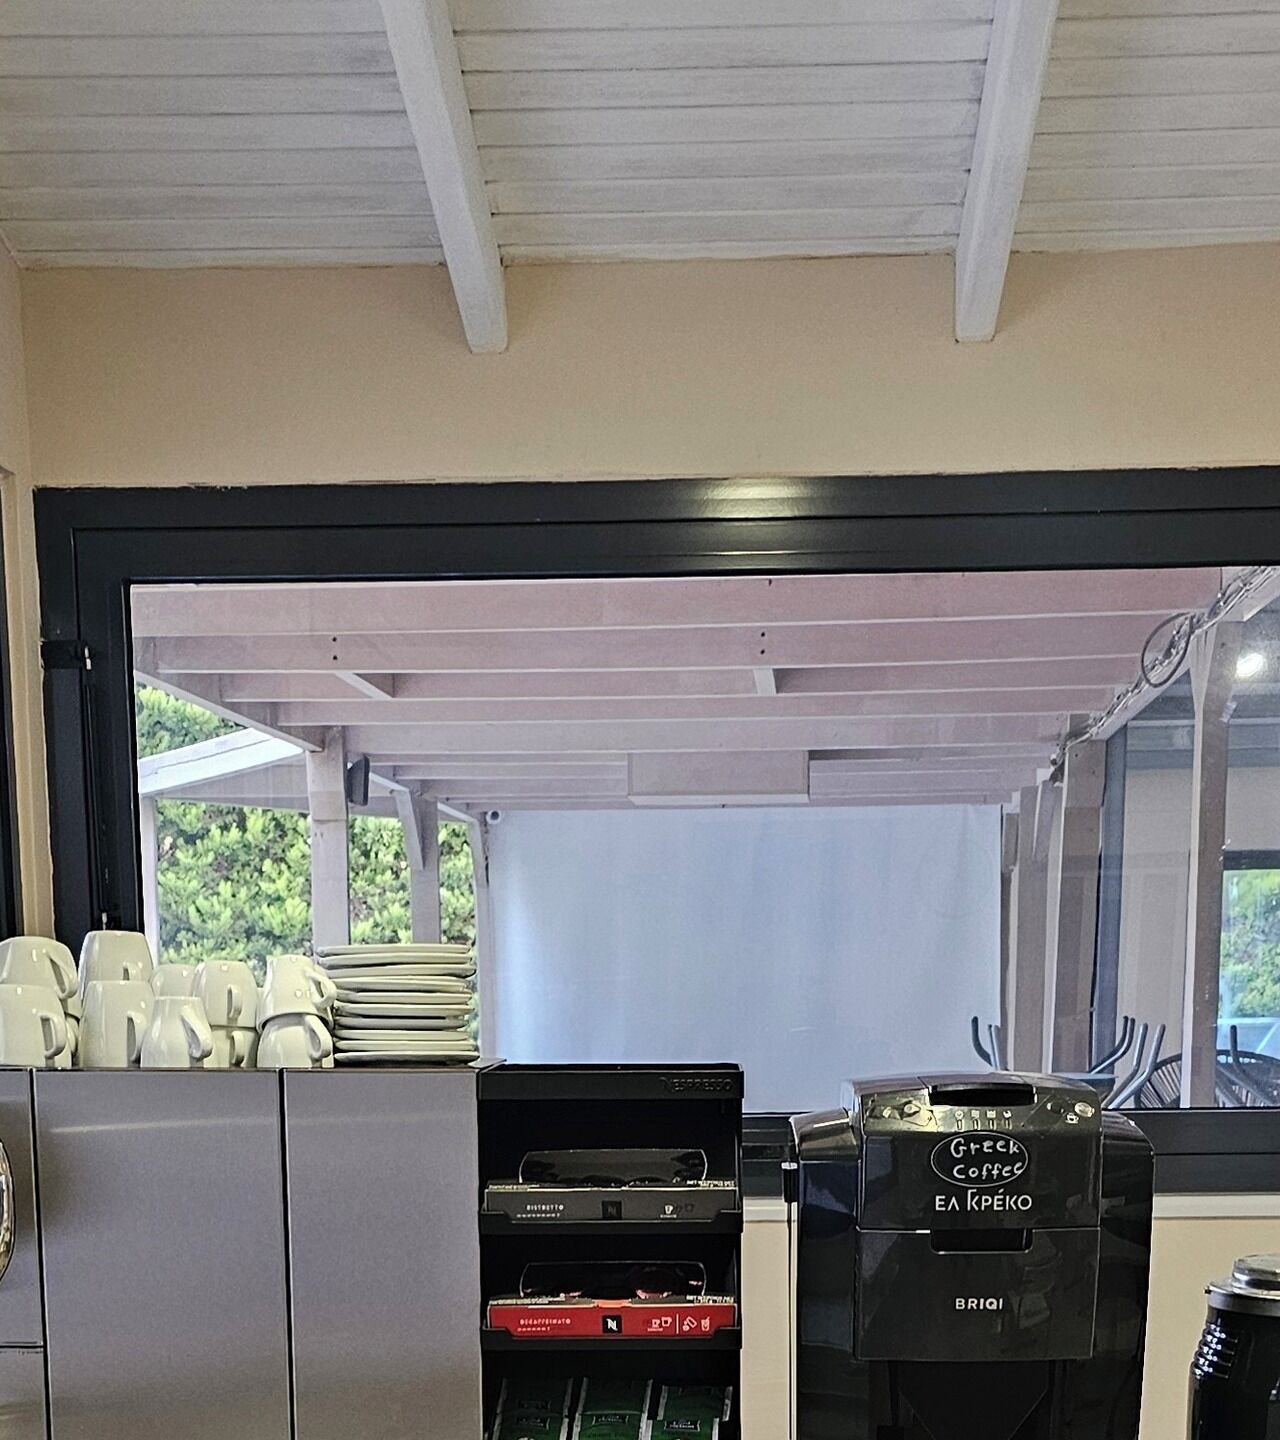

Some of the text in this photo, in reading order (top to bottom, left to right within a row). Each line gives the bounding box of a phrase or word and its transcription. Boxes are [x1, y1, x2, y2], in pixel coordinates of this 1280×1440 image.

[950, 1138, 1020, 1158] Greek
[953, 1162, 1023, 1180] Coffee
[935, 1195, 960, 1211] ΕΛ
